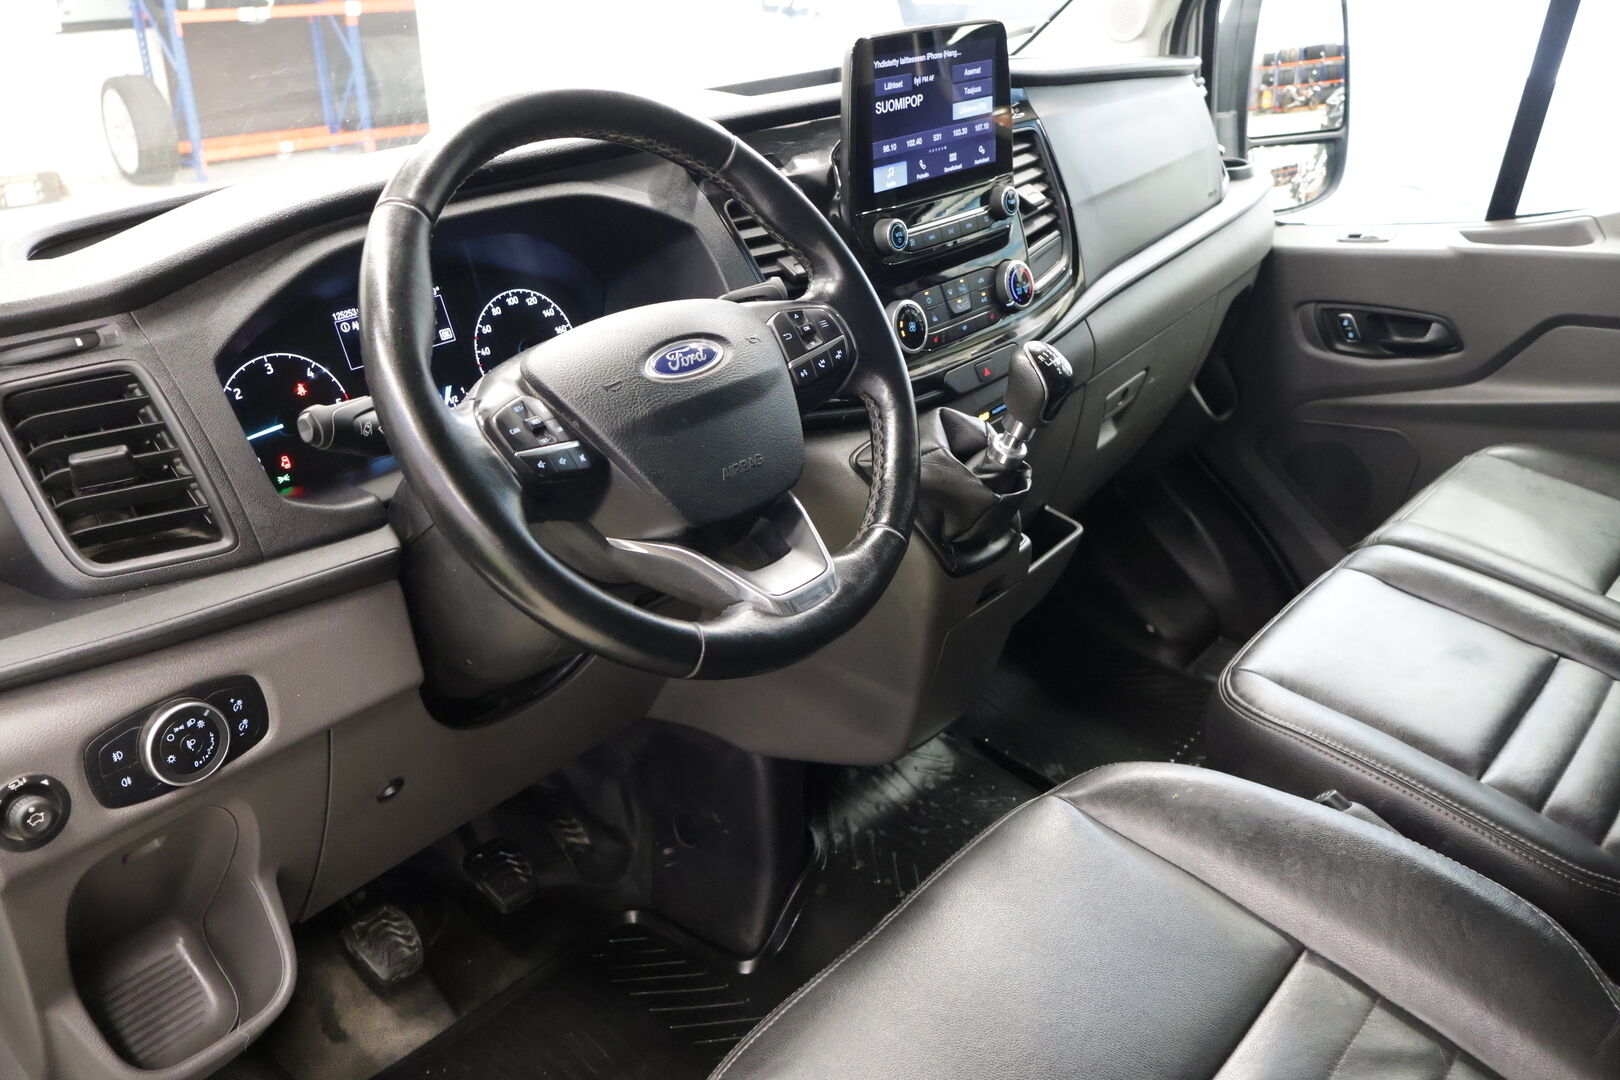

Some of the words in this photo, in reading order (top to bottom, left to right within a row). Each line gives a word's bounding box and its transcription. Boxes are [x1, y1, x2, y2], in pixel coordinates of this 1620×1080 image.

[875, 94, 924, 114] SUOMIPOP
[933, 133, 942, 142] 531
[506, 296, 519, 306] 100
[526, 296, 538, 306] 120
[491, 306, 502, 316] 80
[542, 308, 555, 318] 140
[482, 324, 492, 334] 60
[555, 324, 567, 334] 160
[480, 346, 491, 356] 40
[665, 346, 707, 371] Ford
[264, 363, 274, 375] 3
[306, 367, 315, 378] 4
[233, 388, 243, 400] 2
[721, 453, 764, 481] AIRBAG
